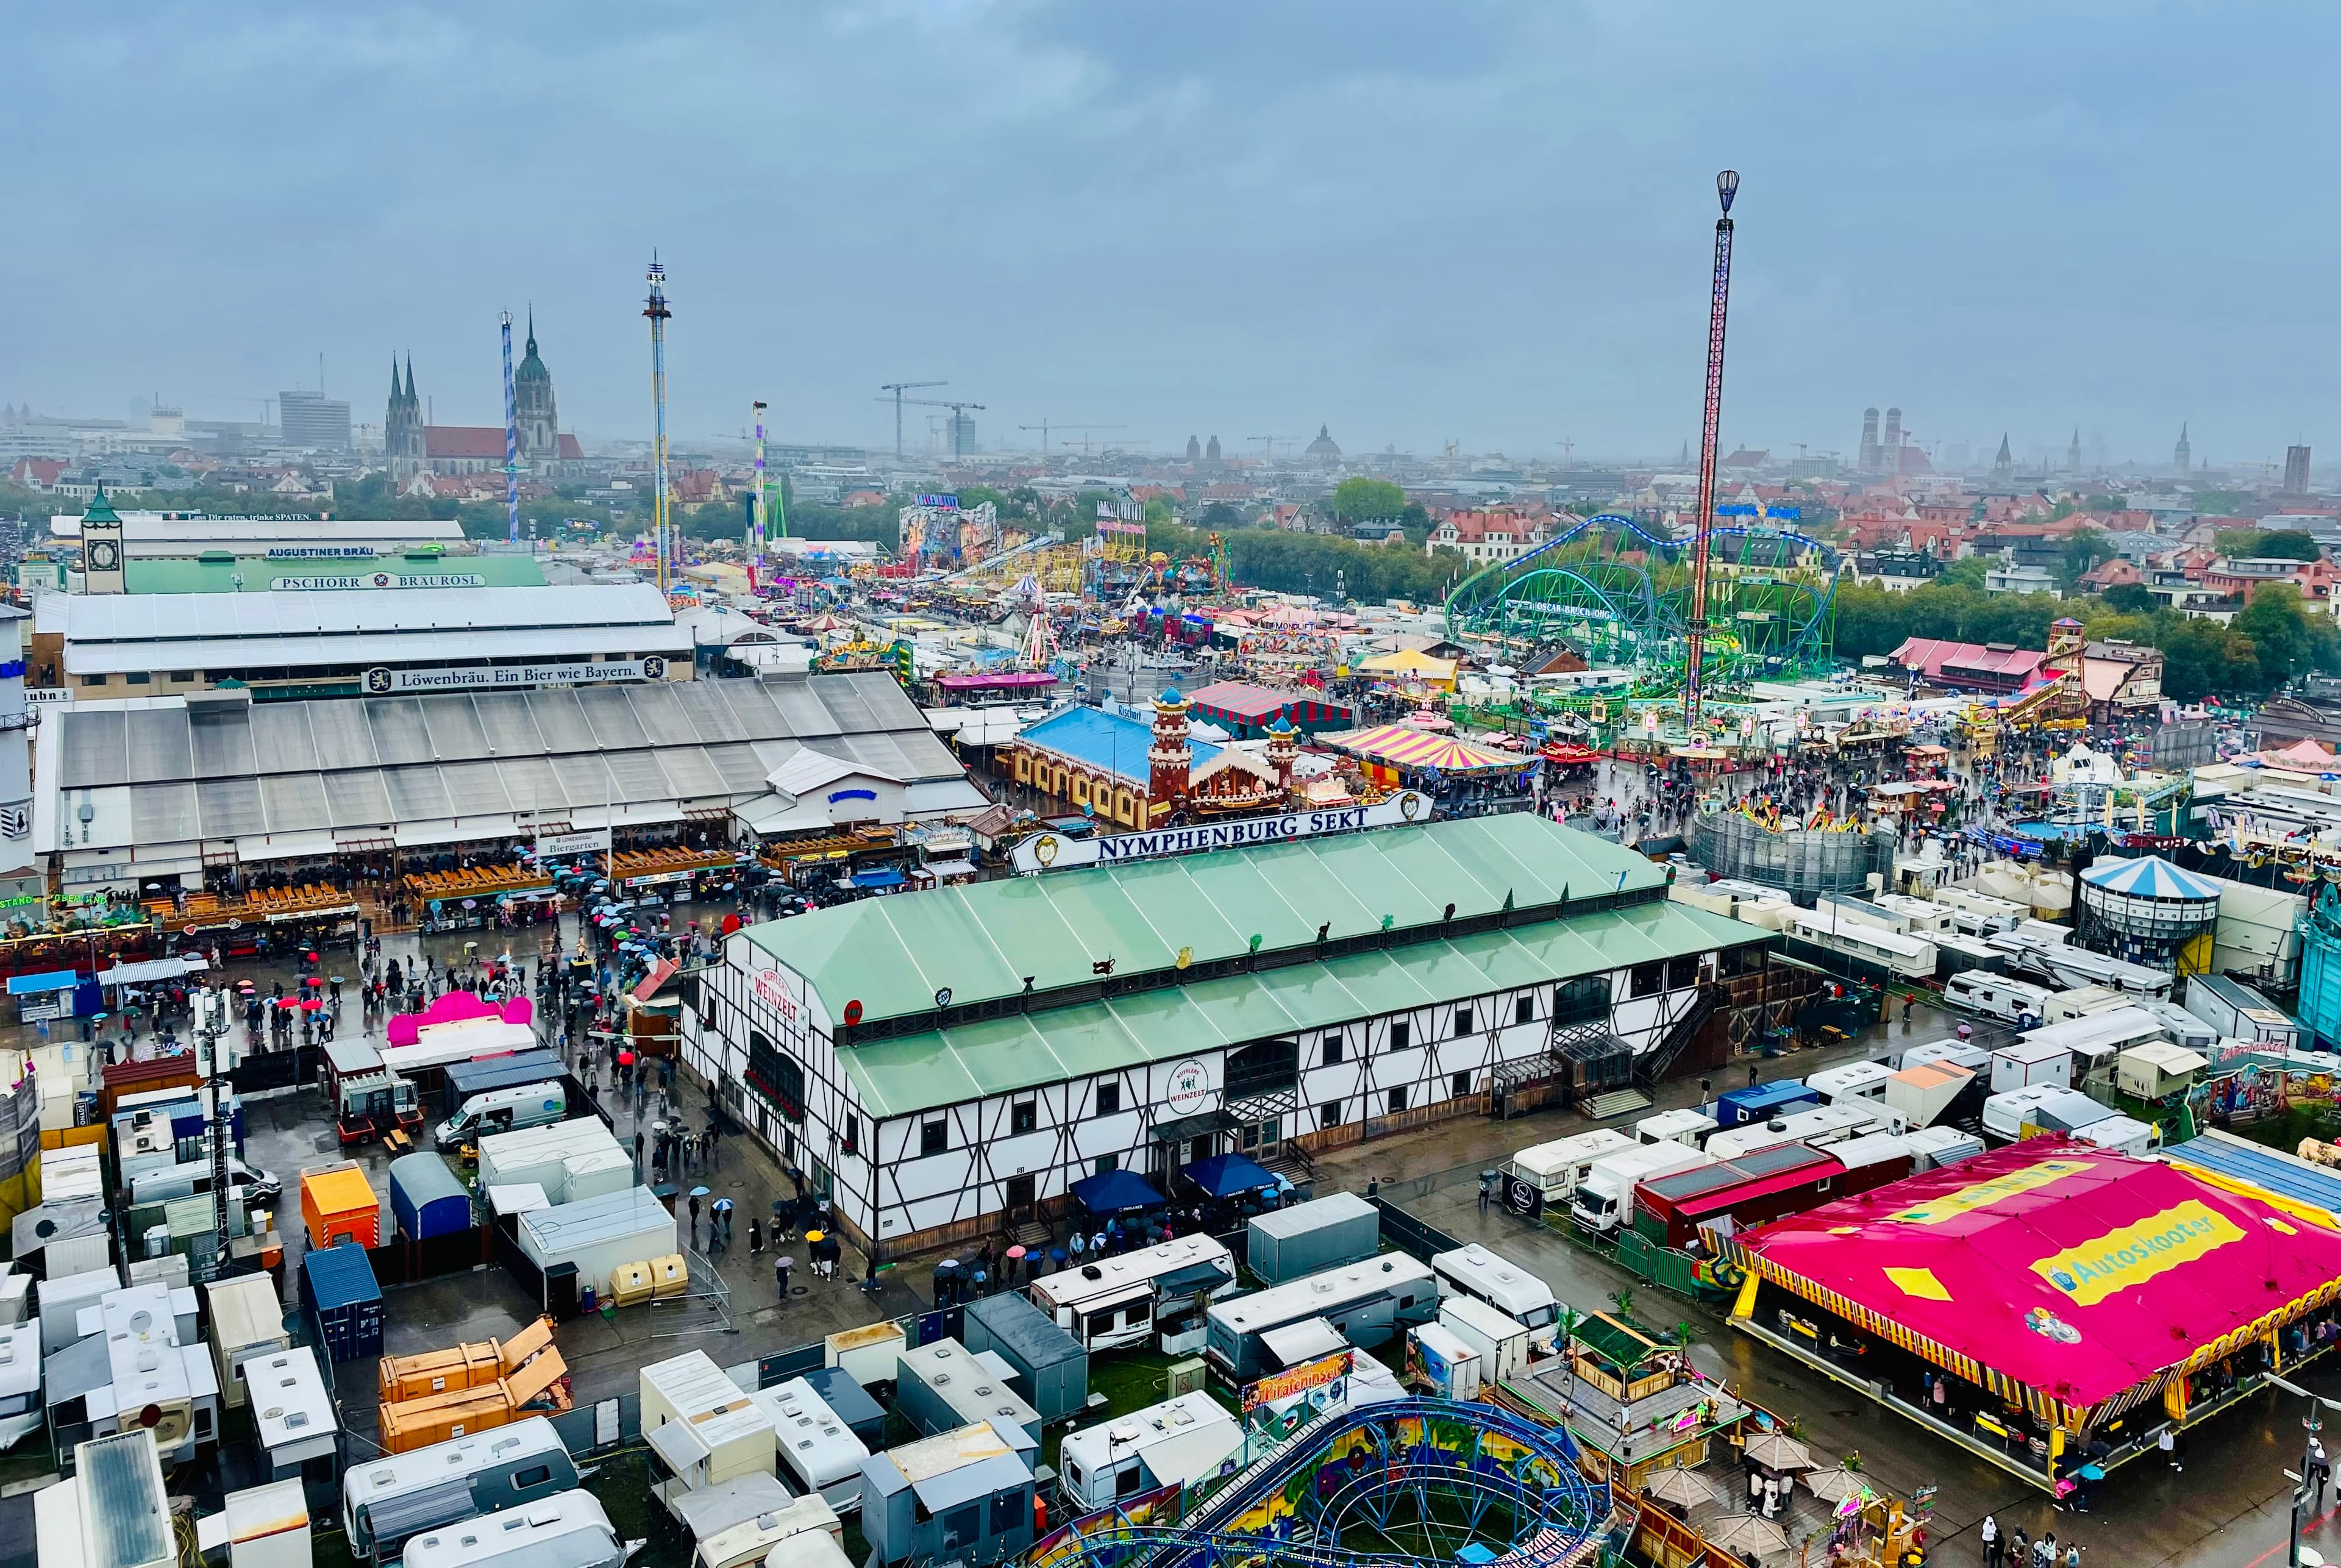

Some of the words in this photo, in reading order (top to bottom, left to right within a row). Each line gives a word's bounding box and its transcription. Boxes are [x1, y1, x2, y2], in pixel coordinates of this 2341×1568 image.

[344, 546, 374, 555] BRÄU
[282, 577, 360, 588] PSCHORR
[399, 575, 479, 586] BRÄUROSL
[1537, 602, 1561, 613] OSCAR
[1564, 605, 1591, 616] BRUCH
[1276, 622, 1315, 630] MONDLIFT
[401, 671, 489, 686] Löwenbräu.
[494, 669, 519, 682] Ein
[524, 668, 553, 682] Bier
[557, 666, 581, 680] wie
[585, 666, 636, 680] Bayern.
[1118, 704, 1142, 721] Rischart
[1099, 816, 1297, 859] NYMPHENBURG
[1311, 808, 1369, 832] SEKT
[549, 842, 599, 853] Biergarten
[763, 971, 788, 996] KUFFLERS
[755, 977, 797, 1023] WEINZELT
[1176, 1068, 1200, 1080] KUFFLERS
[1170, 1089, 1205, 1102] WEINZELT
[2070, 1216, 2217, 1285] Autoskooter
[1258, 1360, 1339, 1402] Pirateninsel
